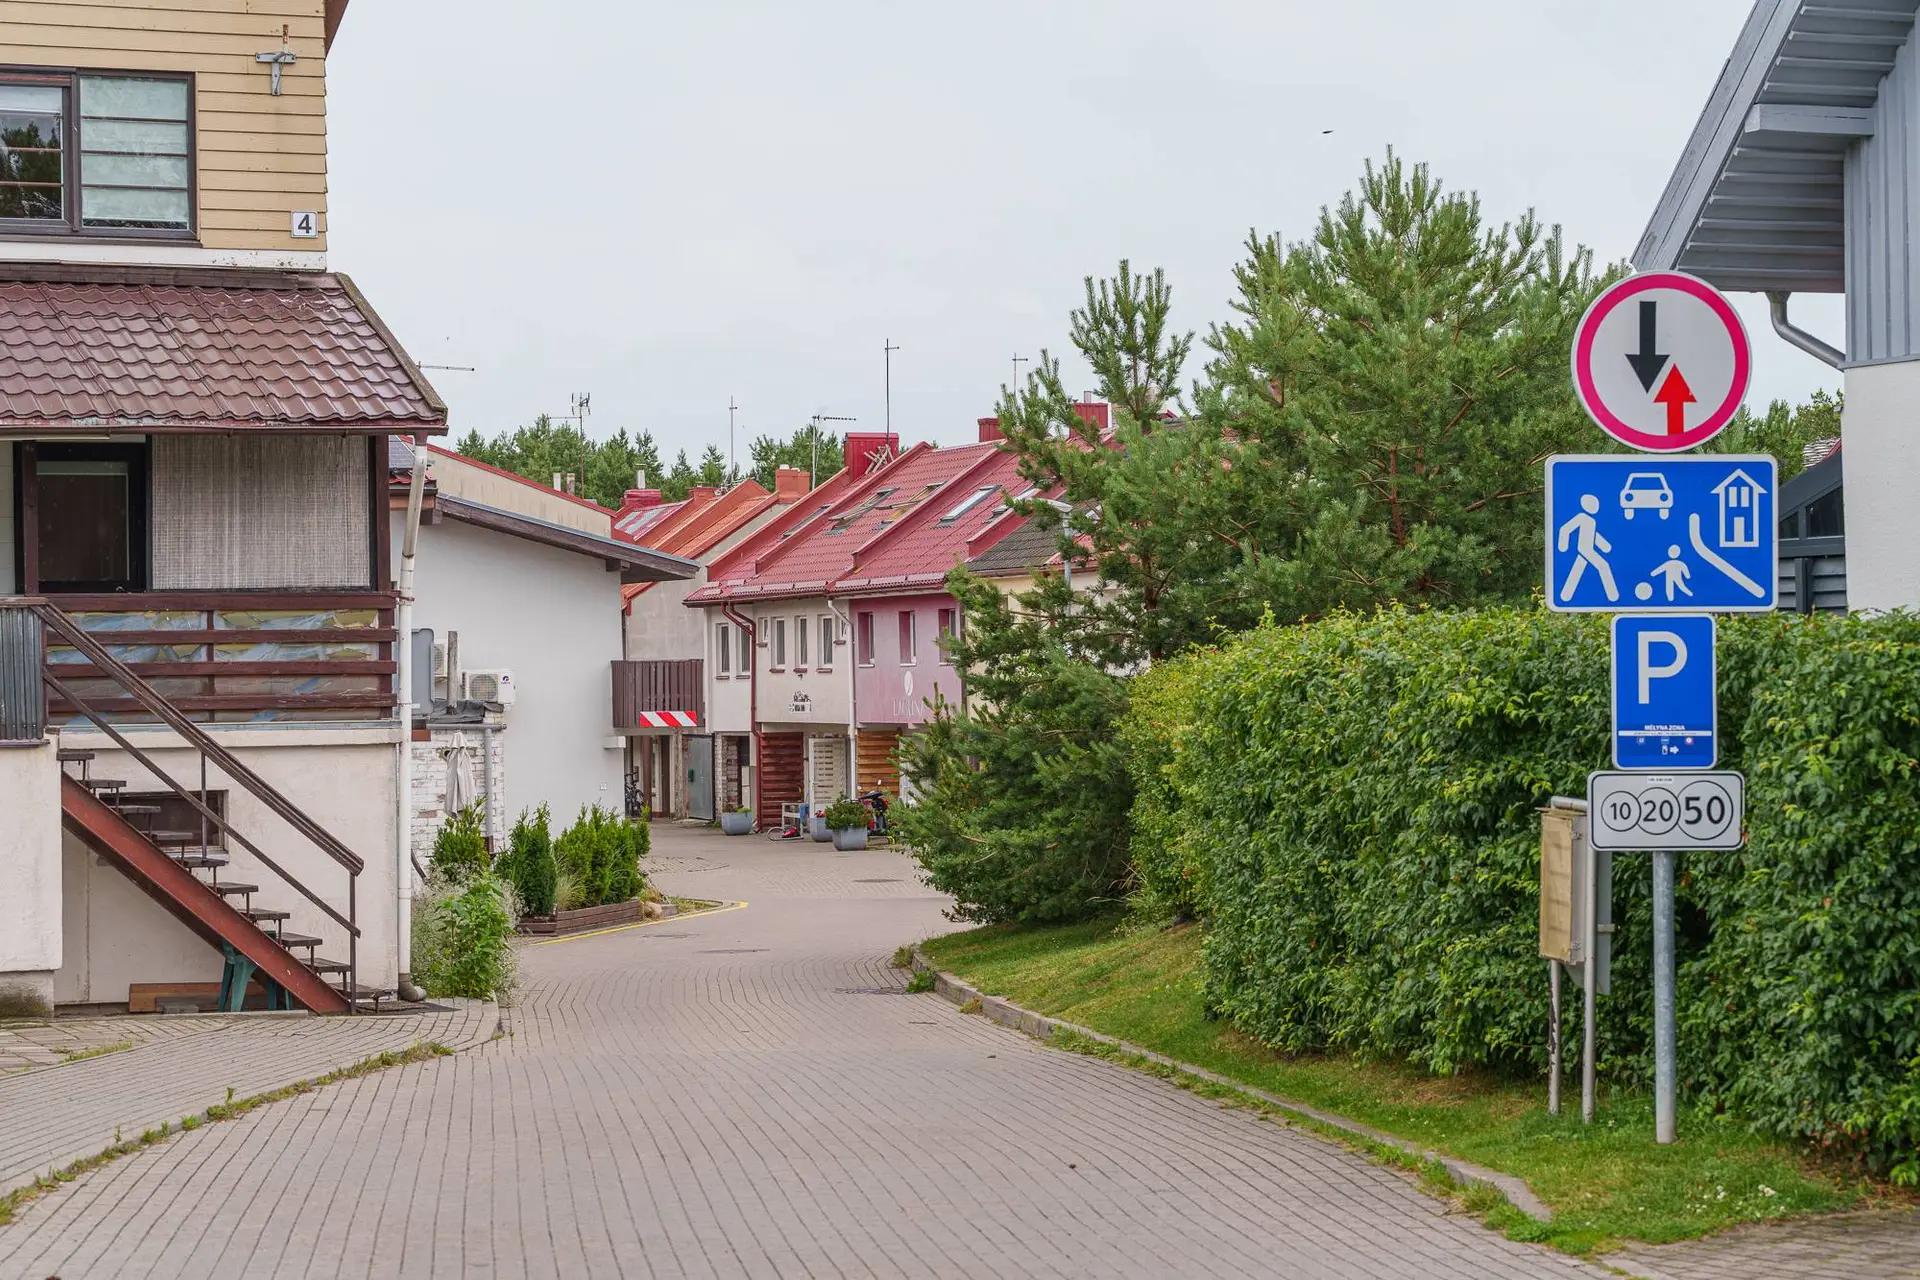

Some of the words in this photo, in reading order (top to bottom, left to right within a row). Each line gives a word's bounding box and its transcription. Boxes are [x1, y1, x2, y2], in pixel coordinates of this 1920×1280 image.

[298, 214, 312, 234] 4
[1638, 631, 1688, 704] P
[1610, 802, 1631, 820] 10
[1643, 800, 1673, 822] 20
[1685, 796, 1725, 824] 50
